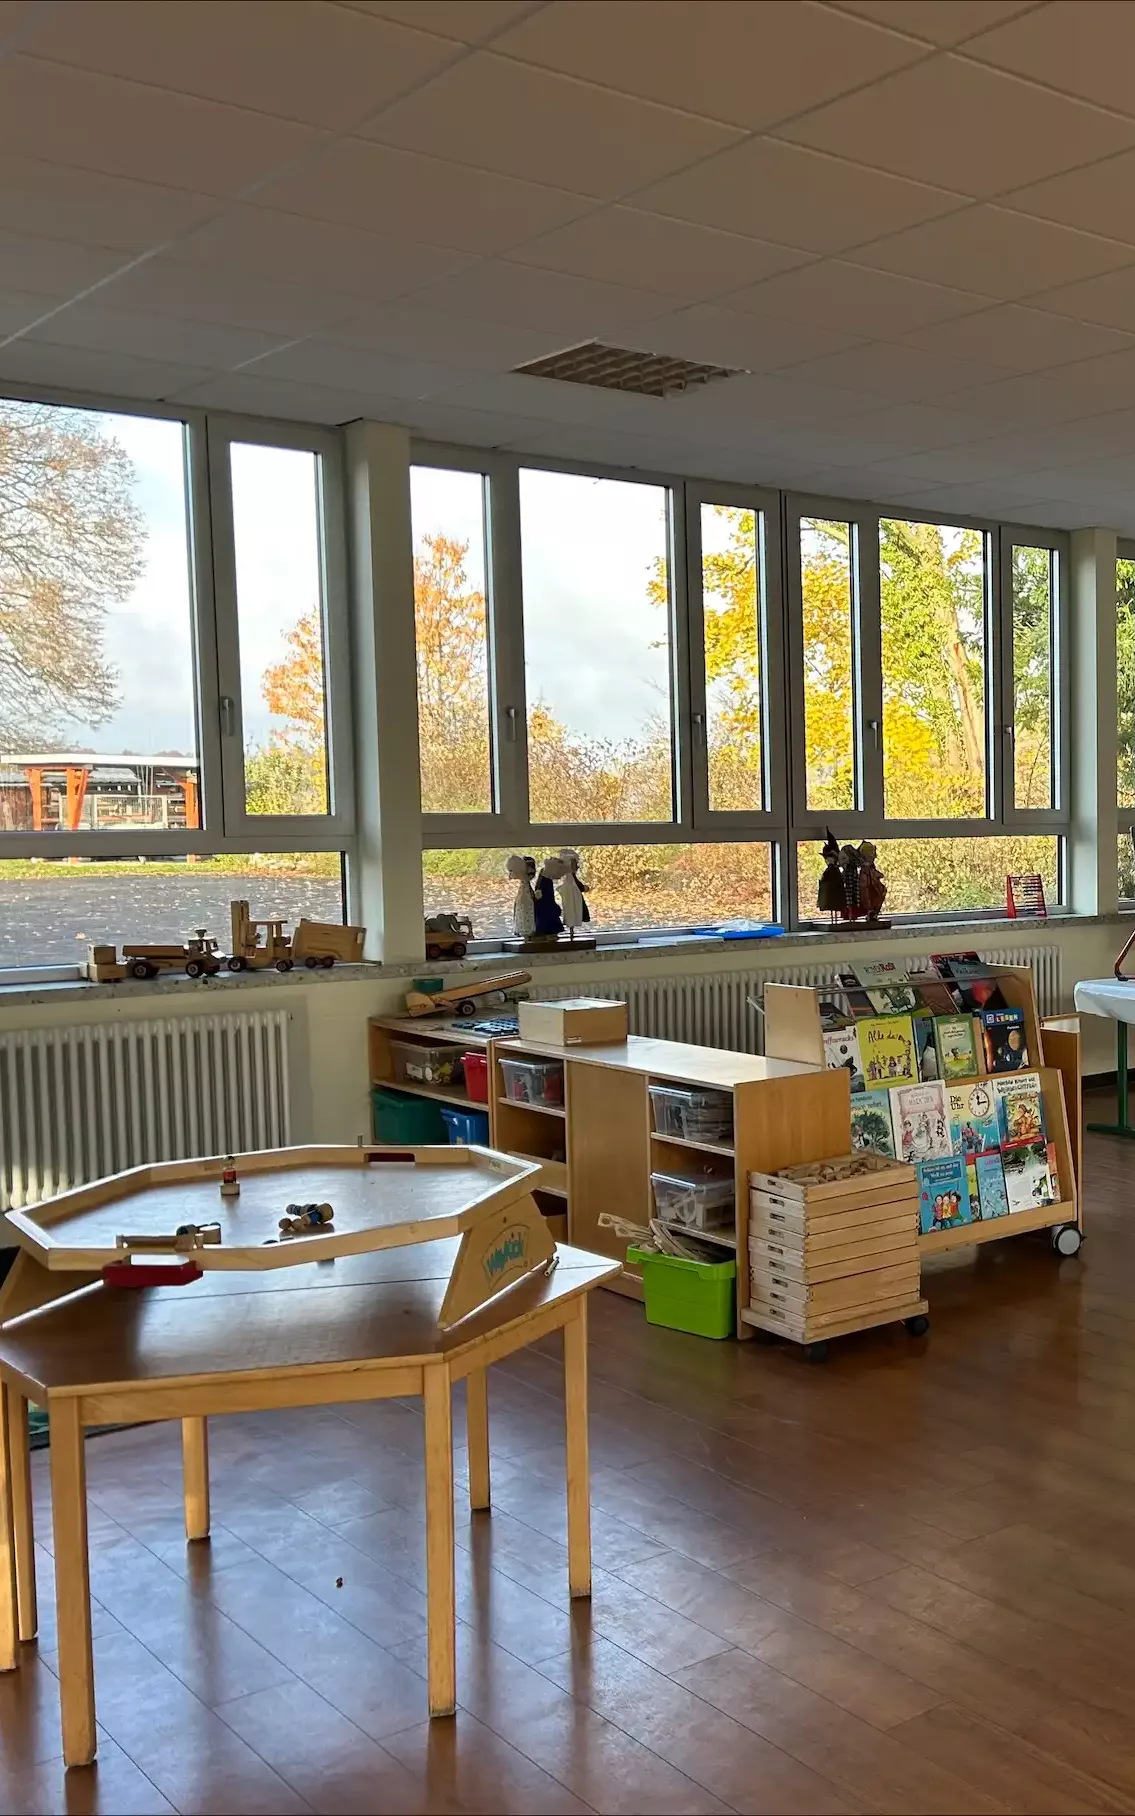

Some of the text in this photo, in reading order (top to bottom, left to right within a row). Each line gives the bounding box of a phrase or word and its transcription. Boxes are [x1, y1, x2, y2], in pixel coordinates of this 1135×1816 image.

[996, 1014, 1019, 1023] LESEN
[868, 1030, 884, 1044] Alle
[949, 1094, 962, 1103] Die
[950, 1102, 964, 1111] Uhr
